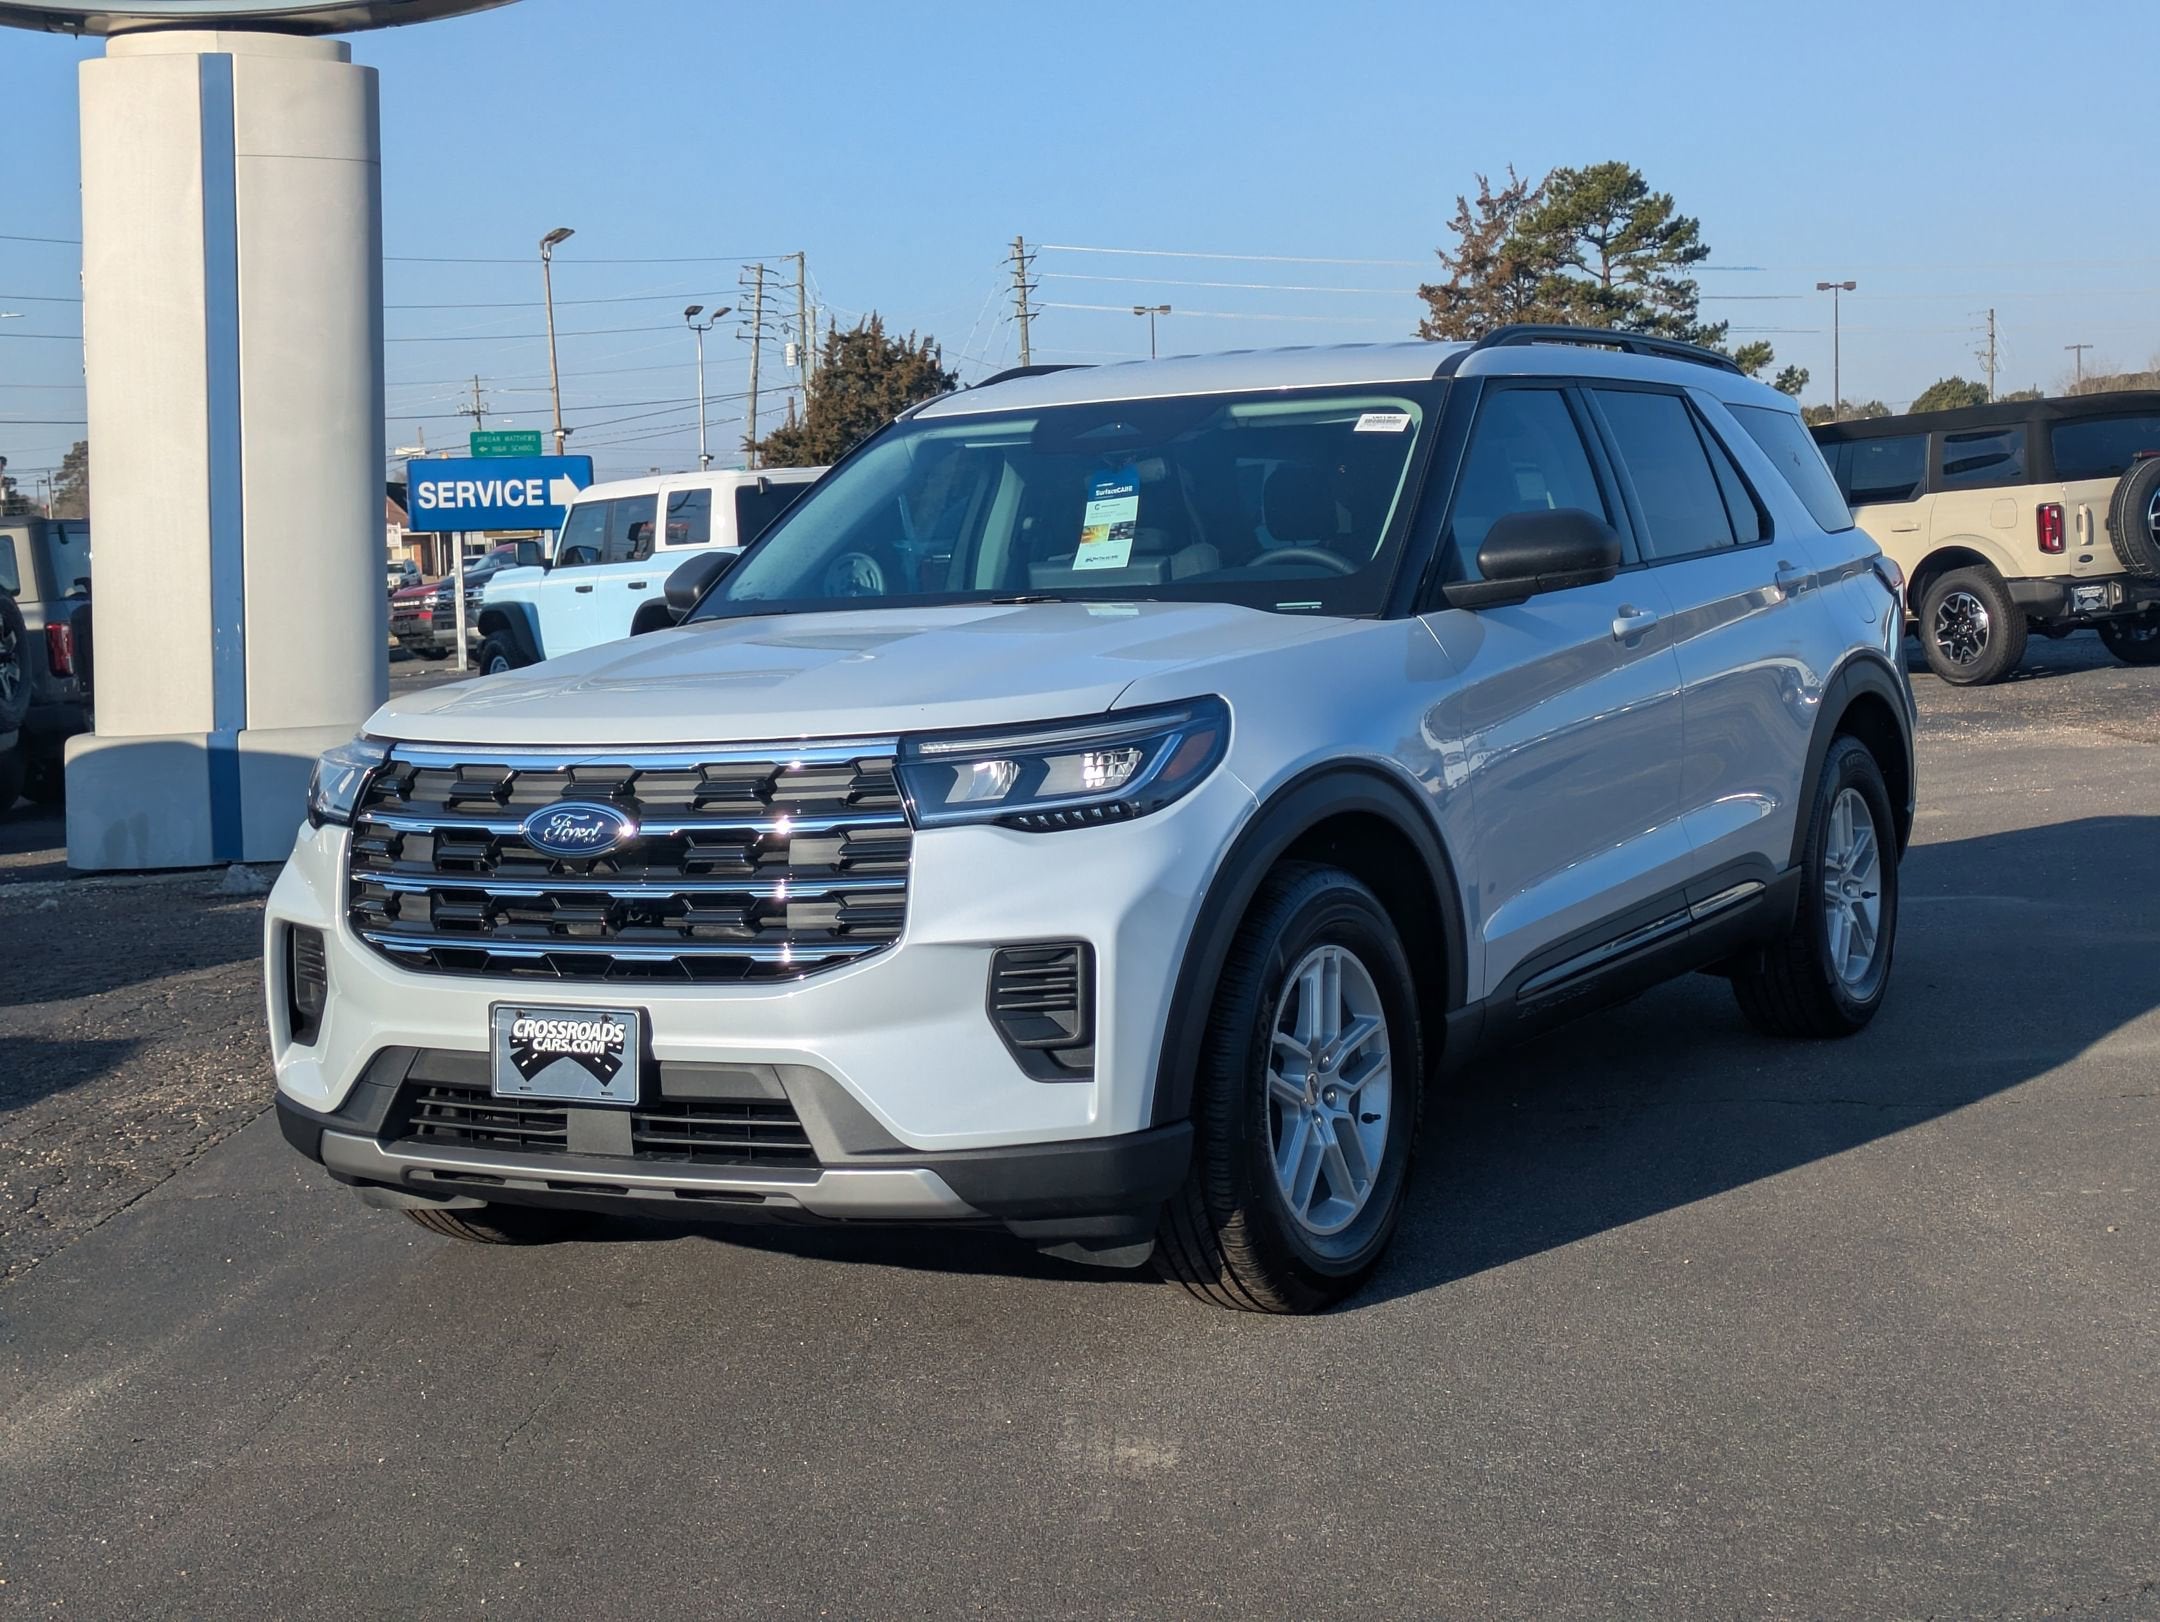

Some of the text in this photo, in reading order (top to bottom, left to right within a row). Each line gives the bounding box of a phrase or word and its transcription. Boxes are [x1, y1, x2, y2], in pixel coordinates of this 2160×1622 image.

[418, 479, 545, 509] SERVICE
[543, 812, 604, 843] Ford
[512, 1018, 625, 1043] CROSSROADS
[532, 1037, 606, 1055] CARS.COM
